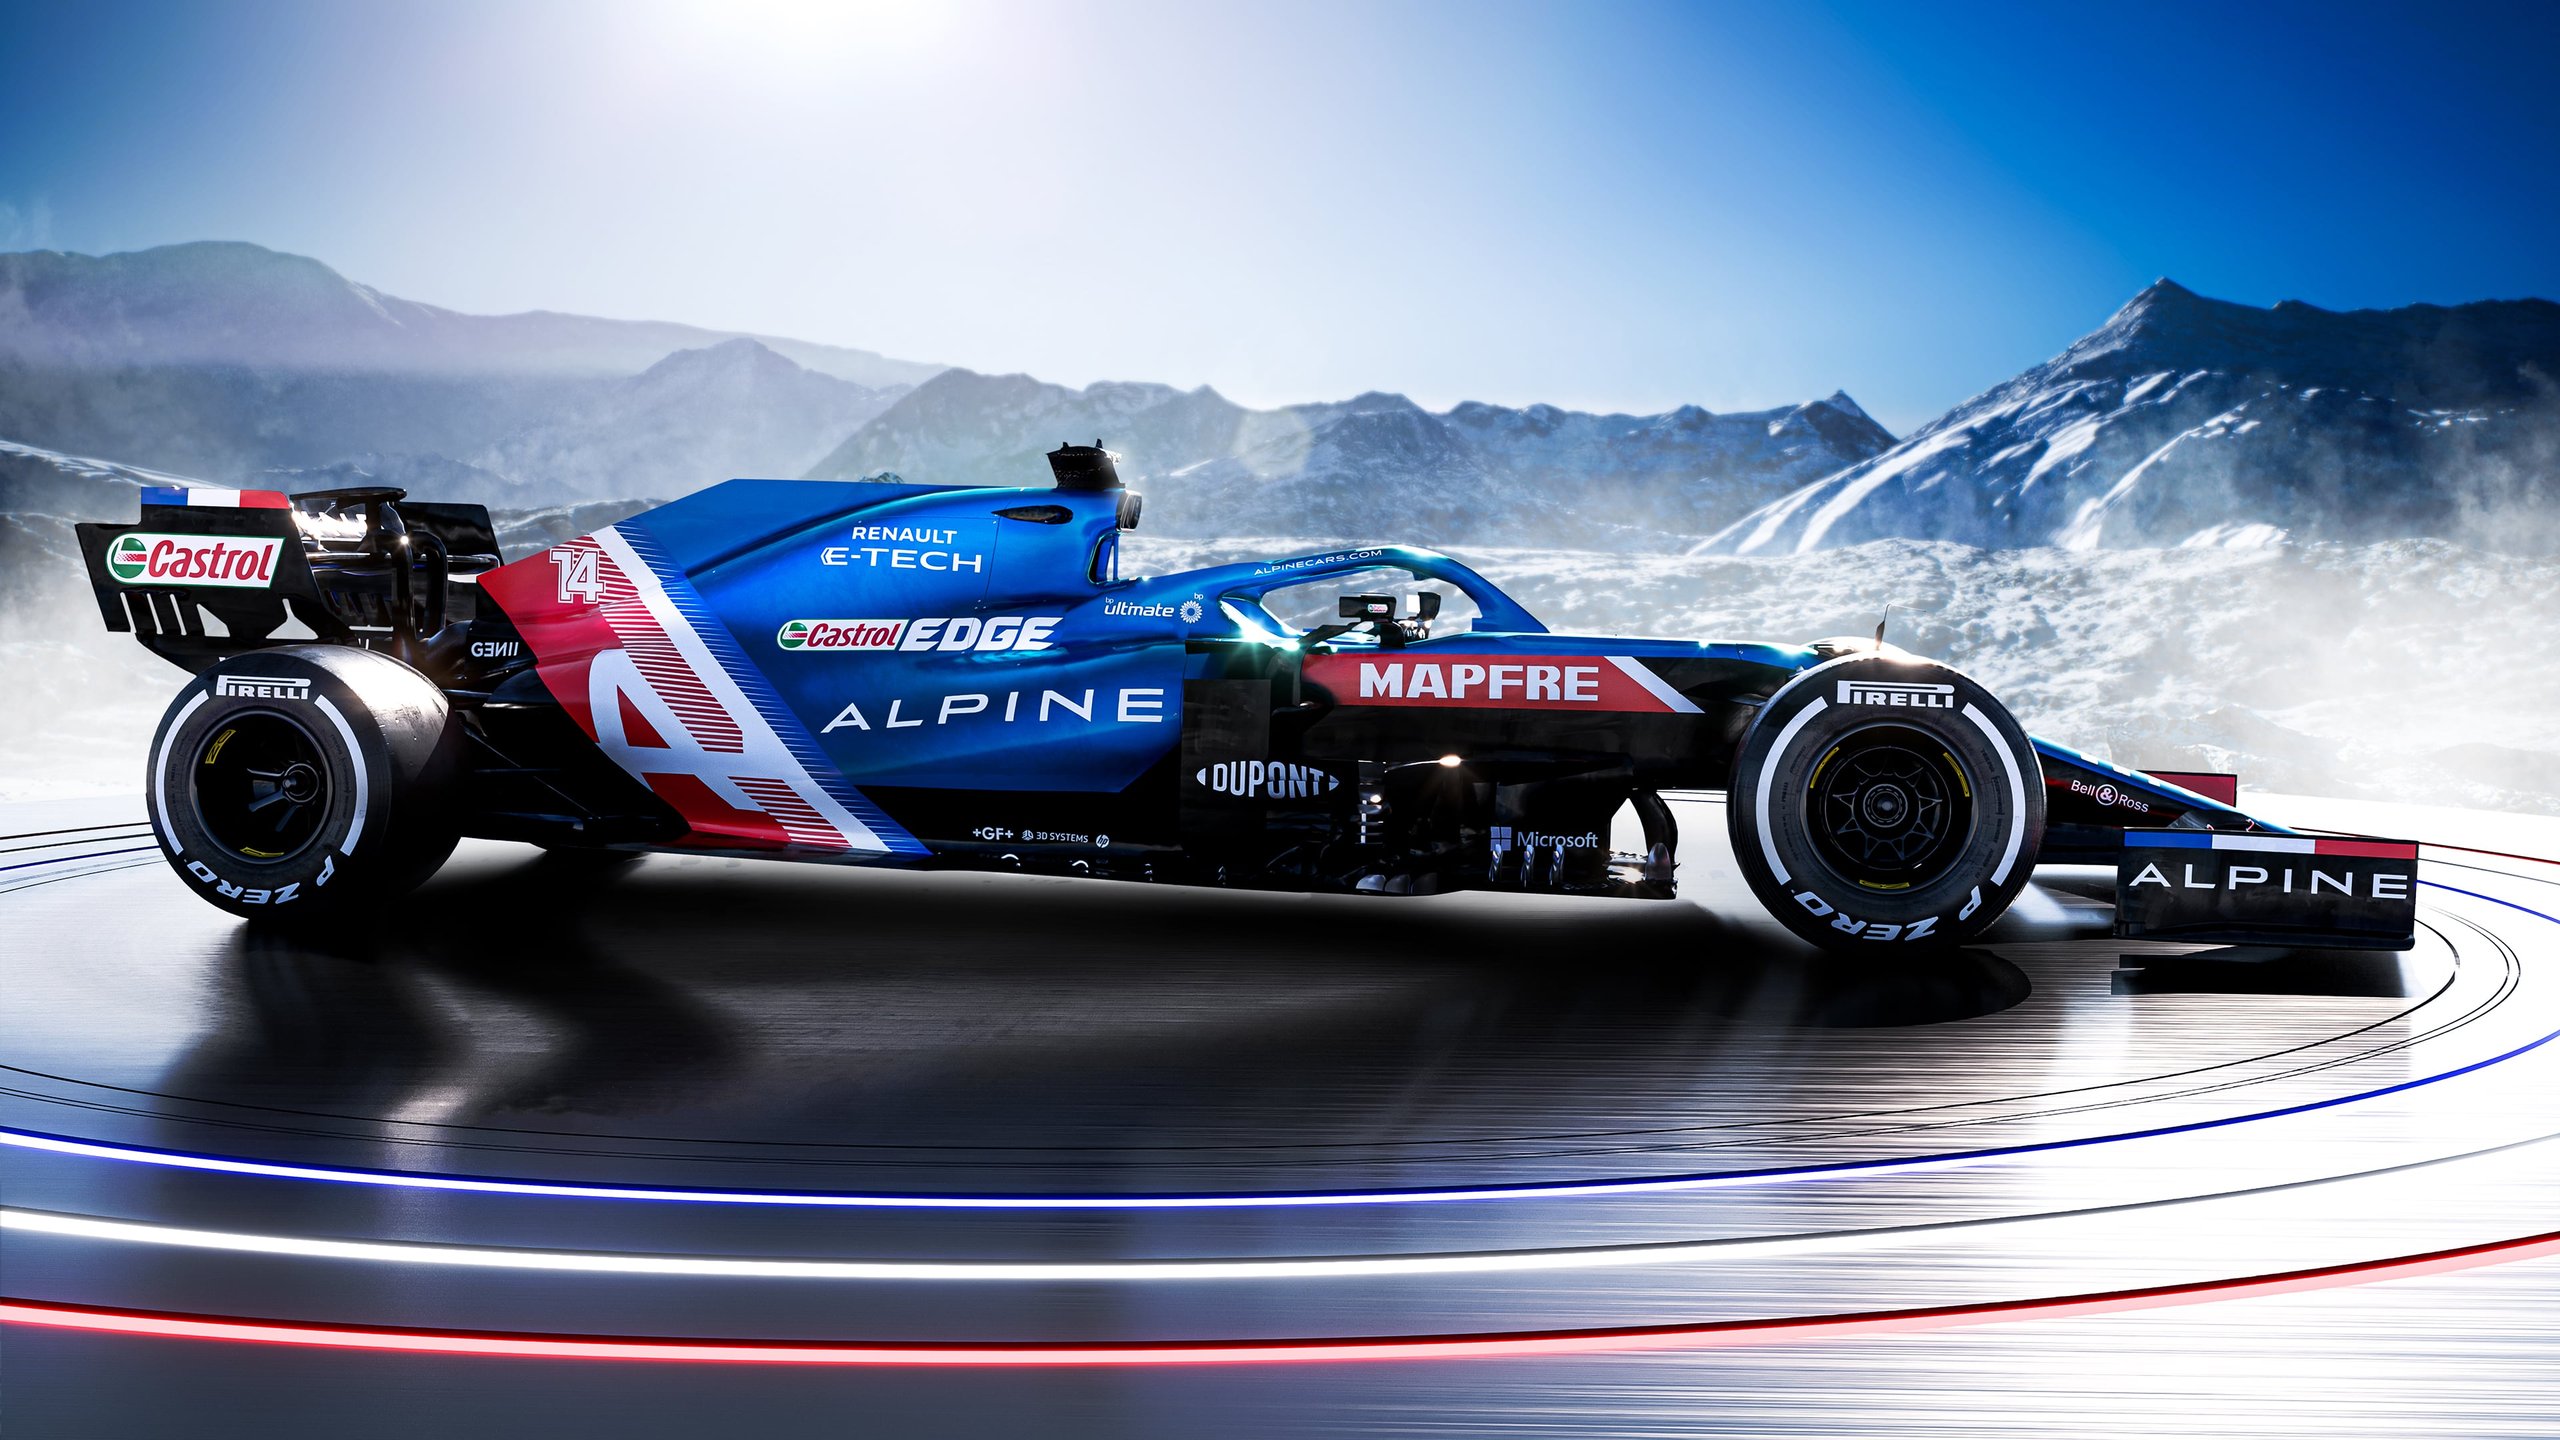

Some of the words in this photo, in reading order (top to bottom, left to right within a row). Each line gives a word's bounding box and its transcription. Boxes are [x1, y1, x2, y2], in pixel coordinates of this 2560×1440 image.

[852, 527, 957, 544] RENAULT
[148, 540, 273, 580] Castrol
[550, 549, 605, 604] 14
[820, 547, 982, 573] E-TECH
[1254, 550, 1382, 575] ALPINECARS.COM
[1104, 601, 1175, 617] ultimate
[1194, 592, 1204, 600] bp
[807, 623, 901, 647] Castrol
[899, 617, 1064, 651] EDGE
[216, 675, 311, 700] PIRELLI
[1360, 663, 1599, 701] MAPFRE
[1837, 680, 1955, 708] PIRELLI
[820, 689, 1164, 733] ALPINE
[1213, 760, 1324, 799] DUPONT
[2071, 780, 2095, 796] Bell
[2118, 794, 2149, 813] Ross
[1036, 832, 1047, 840] 3D
[1050, 833, 1088, 843] SYSTEMS
[1517, 832, 1598, 848] Microsoft
[186, 860, 300, 904] ZERO
[316, 855, 334, 886] P
[2129, 862, 2408, 899] ALPINE
[1794, 891, 1938, 941] ZERO
[1959, 885, 1981, 921] P
